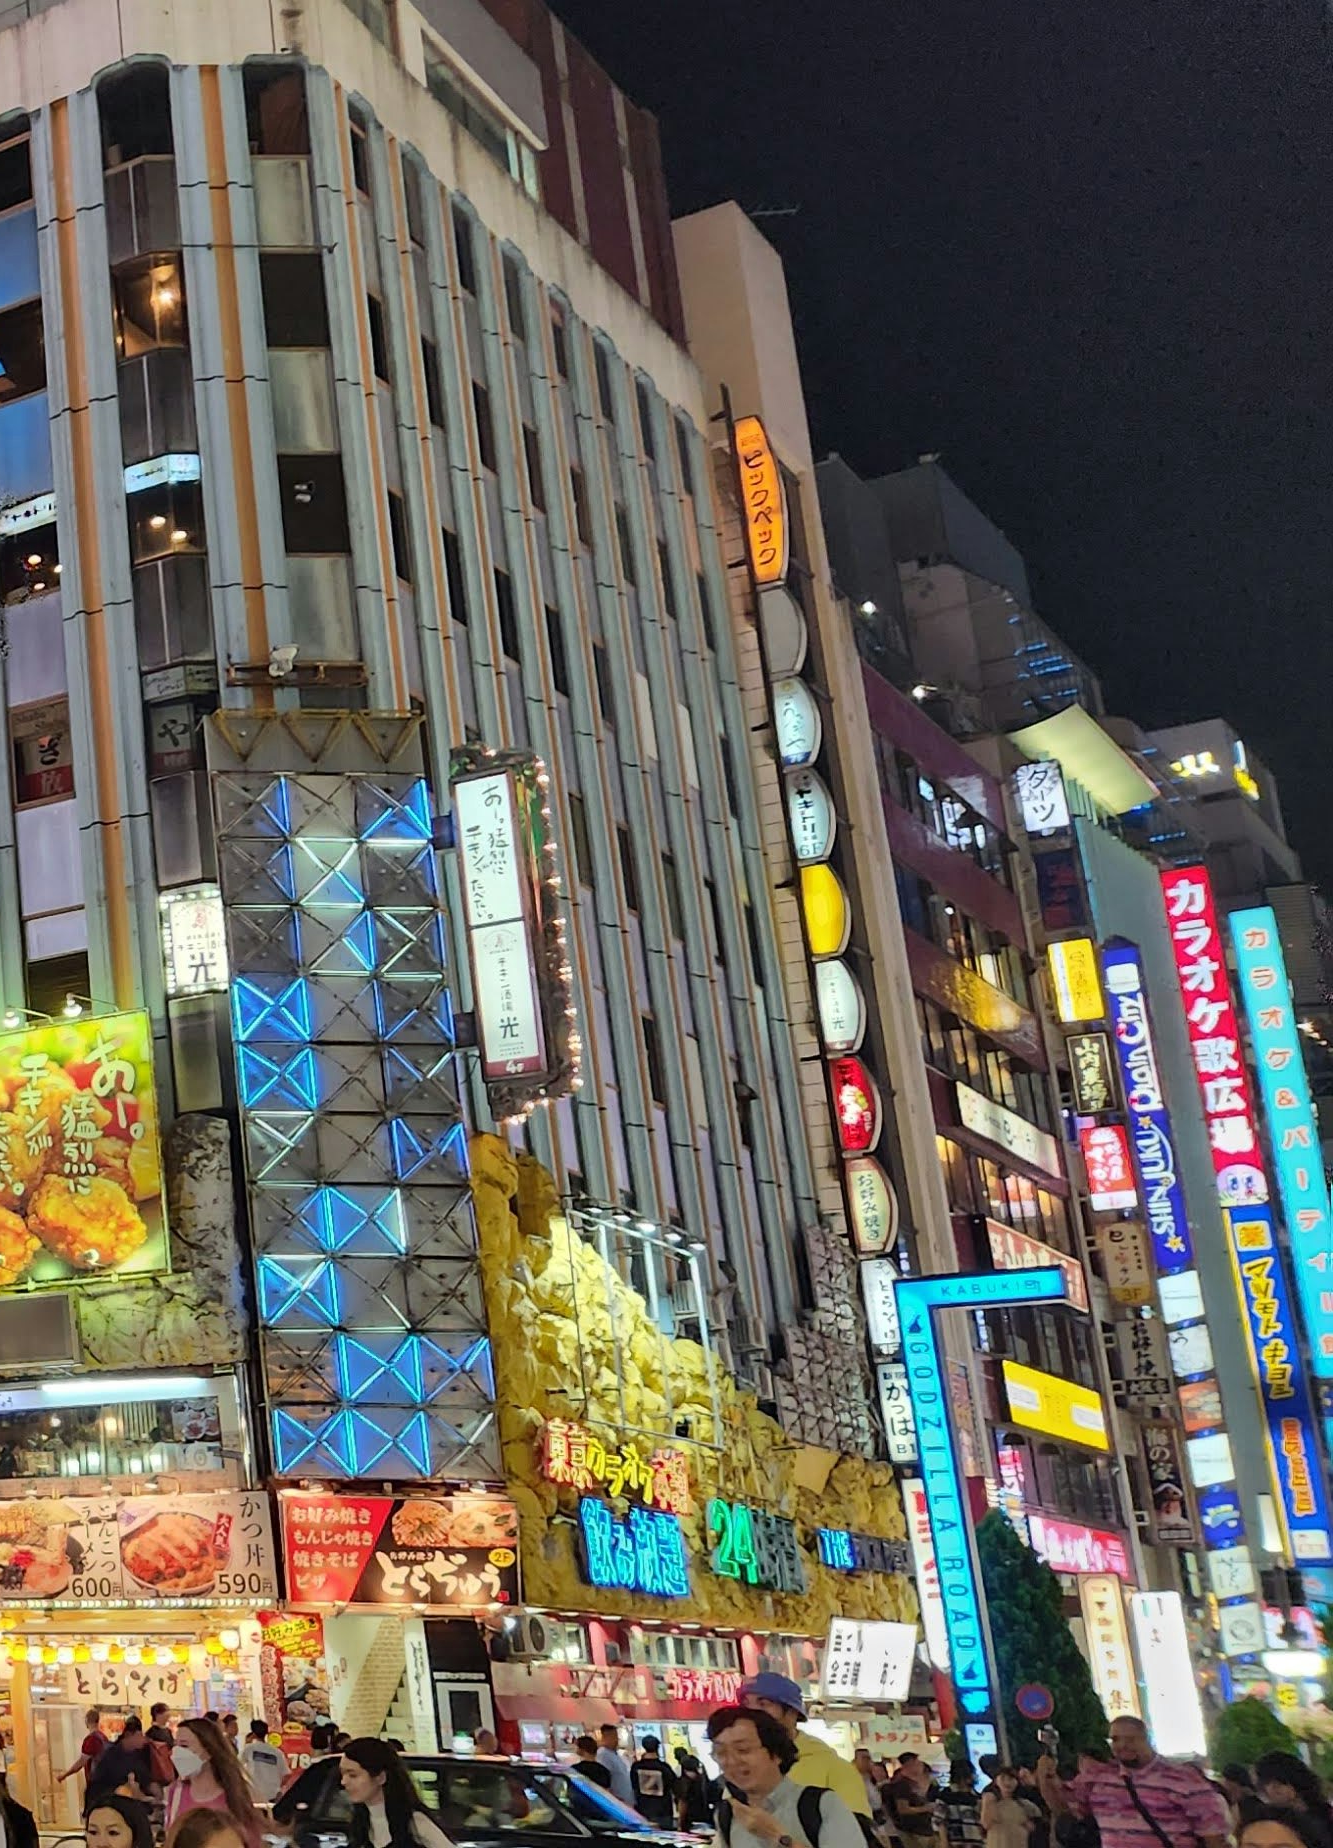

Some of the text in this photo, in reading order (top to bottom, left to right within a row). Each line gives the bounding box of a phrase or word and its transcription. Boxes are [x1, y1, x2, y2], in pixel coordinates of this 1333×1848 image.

[158, 719, 188, 746] や
[500, 1015, 519, 1038] 光
[20, 1054, 52, 1156] チキンが
[62, 1094, 103, 1193] 猛烈に
[1135, 1130, 1176, 1236] SHINJUKU
[858, 1175, 879, 1240] お好み焼き
[897, 1443, 916, 1454] B1
[909, 1342, 954, 1533] GODZILLA
[942, 1556, 976, 1650] ROAD
[292, 1507, 371, 1526] お好み焼き
[81, 1505, 98, 1573] ラーメン
[99, 1504, 116, 1572] とんこつ
[240, 1496, 264, 1568] かつ丼
[293, 1530, 373, 1546] もんじゃ焼き
[293, 1550, 359, 1568] 焼きそば
[493, 1551, 512, 1563] 2F
[72, 1577, 122, 1598] 600円
[219, 1572, 273, 1596] 590円
[76, 1668, 186, 1696] とらそば
[874, 1731, 922, 1744] トラノコ
